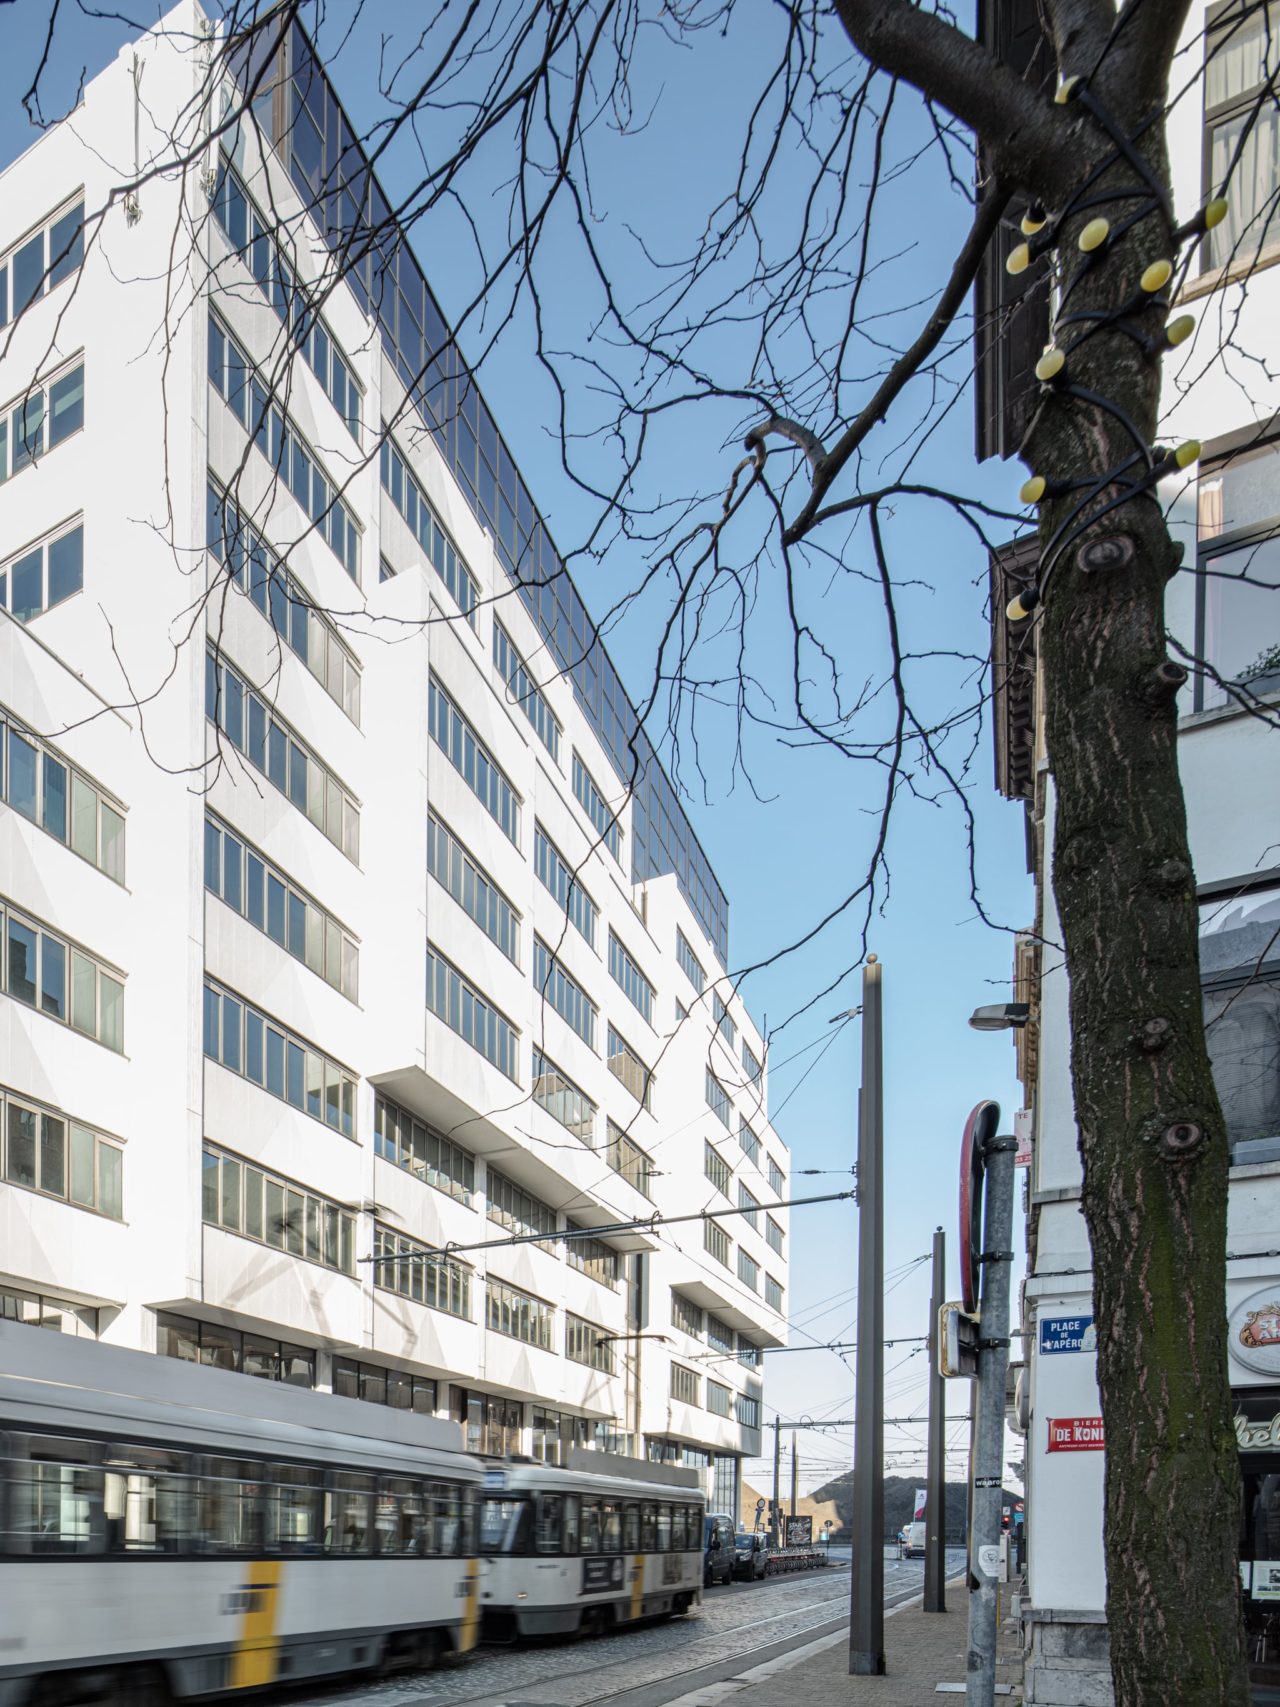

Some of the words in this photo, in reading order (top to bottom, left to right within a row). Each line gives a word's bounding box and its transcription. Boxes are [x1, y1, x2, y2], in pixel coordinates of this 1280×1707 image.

[1051, 1321, 1080, 1331] PLACE
[1056, 1428, 1071, 1441] DE
[1074, 1427, 1104, 1440] KONI
